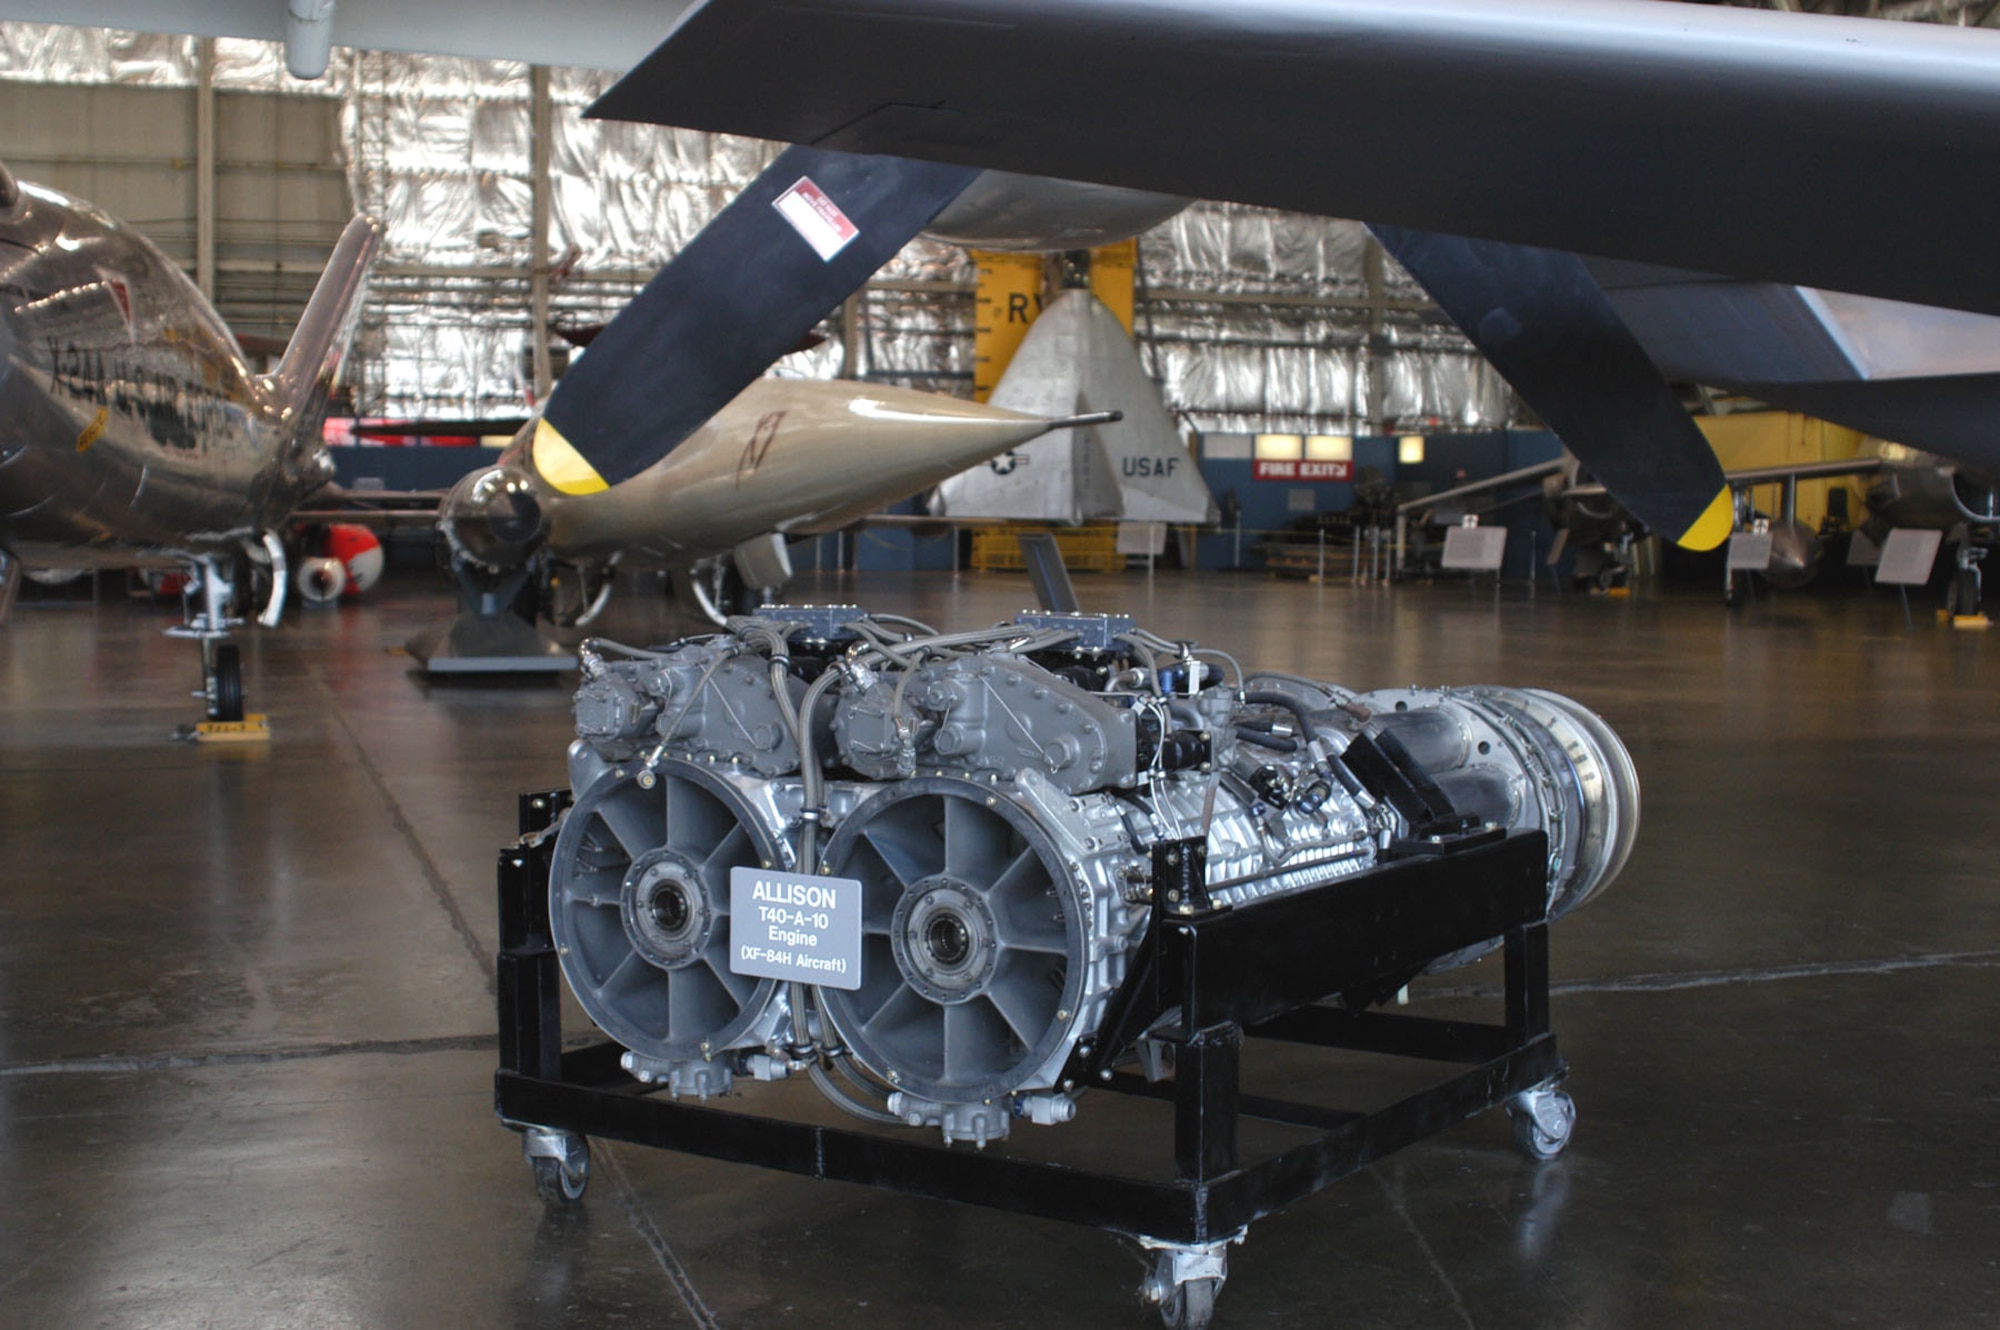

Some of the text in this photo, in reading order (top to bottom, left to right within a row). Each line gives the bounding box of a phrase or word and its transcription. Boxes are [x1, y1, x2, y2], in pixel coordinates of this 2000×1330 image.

[1122, 456, 1180, 478] USAF
[1259, 461, 1296, 476] FIRE
[752, 881, 836, 909] ALLISON
[758, 906, 829, 929] T40-A-10
[768, 925, 818, 946] Engine
[741, 945, 847, 973] (XF-84H Aircraft)
